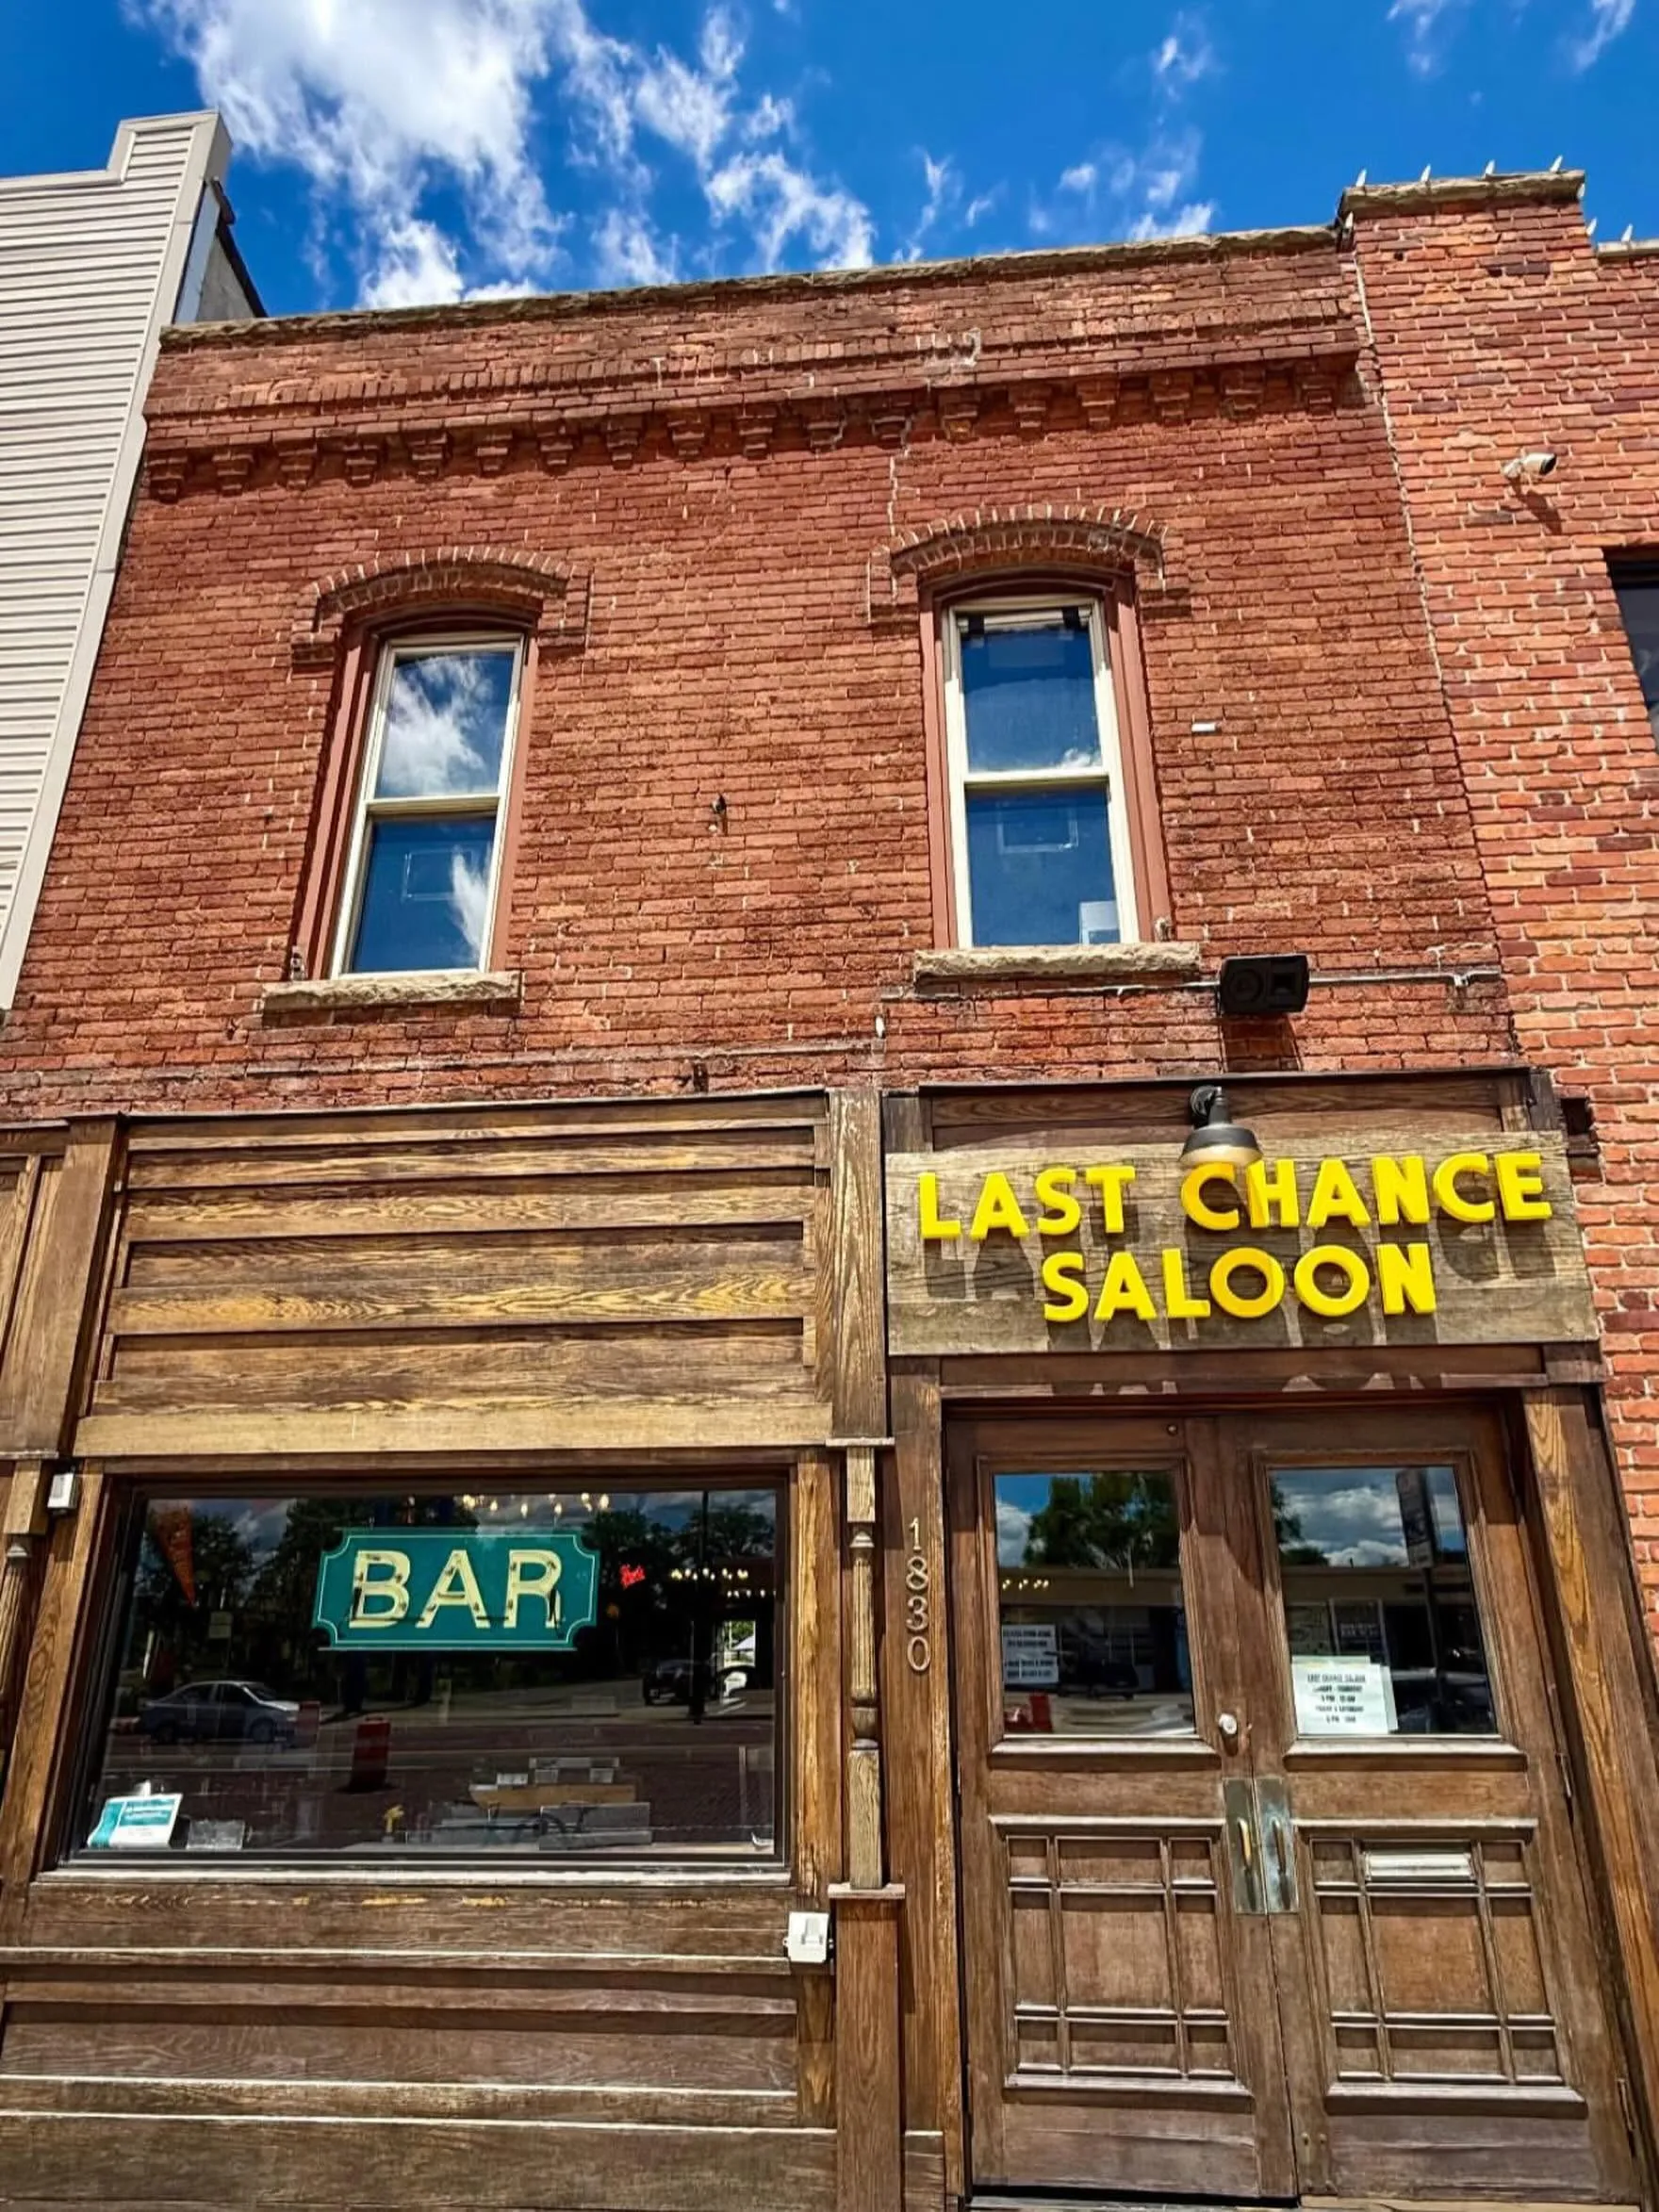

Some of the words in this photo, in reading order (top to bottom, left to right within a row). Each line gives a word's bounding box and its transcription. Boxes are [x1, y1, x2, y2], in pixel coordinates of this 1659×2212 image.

[917, 1166, 1137, 1239] LAST
[1180, 1152, 1553, 1230] CHANCE
[1042, 1242, 1438, 1321] SALOON
[348, 1548, 563, 1630] BAR
[905, 1516, 931, 1672] 1830
